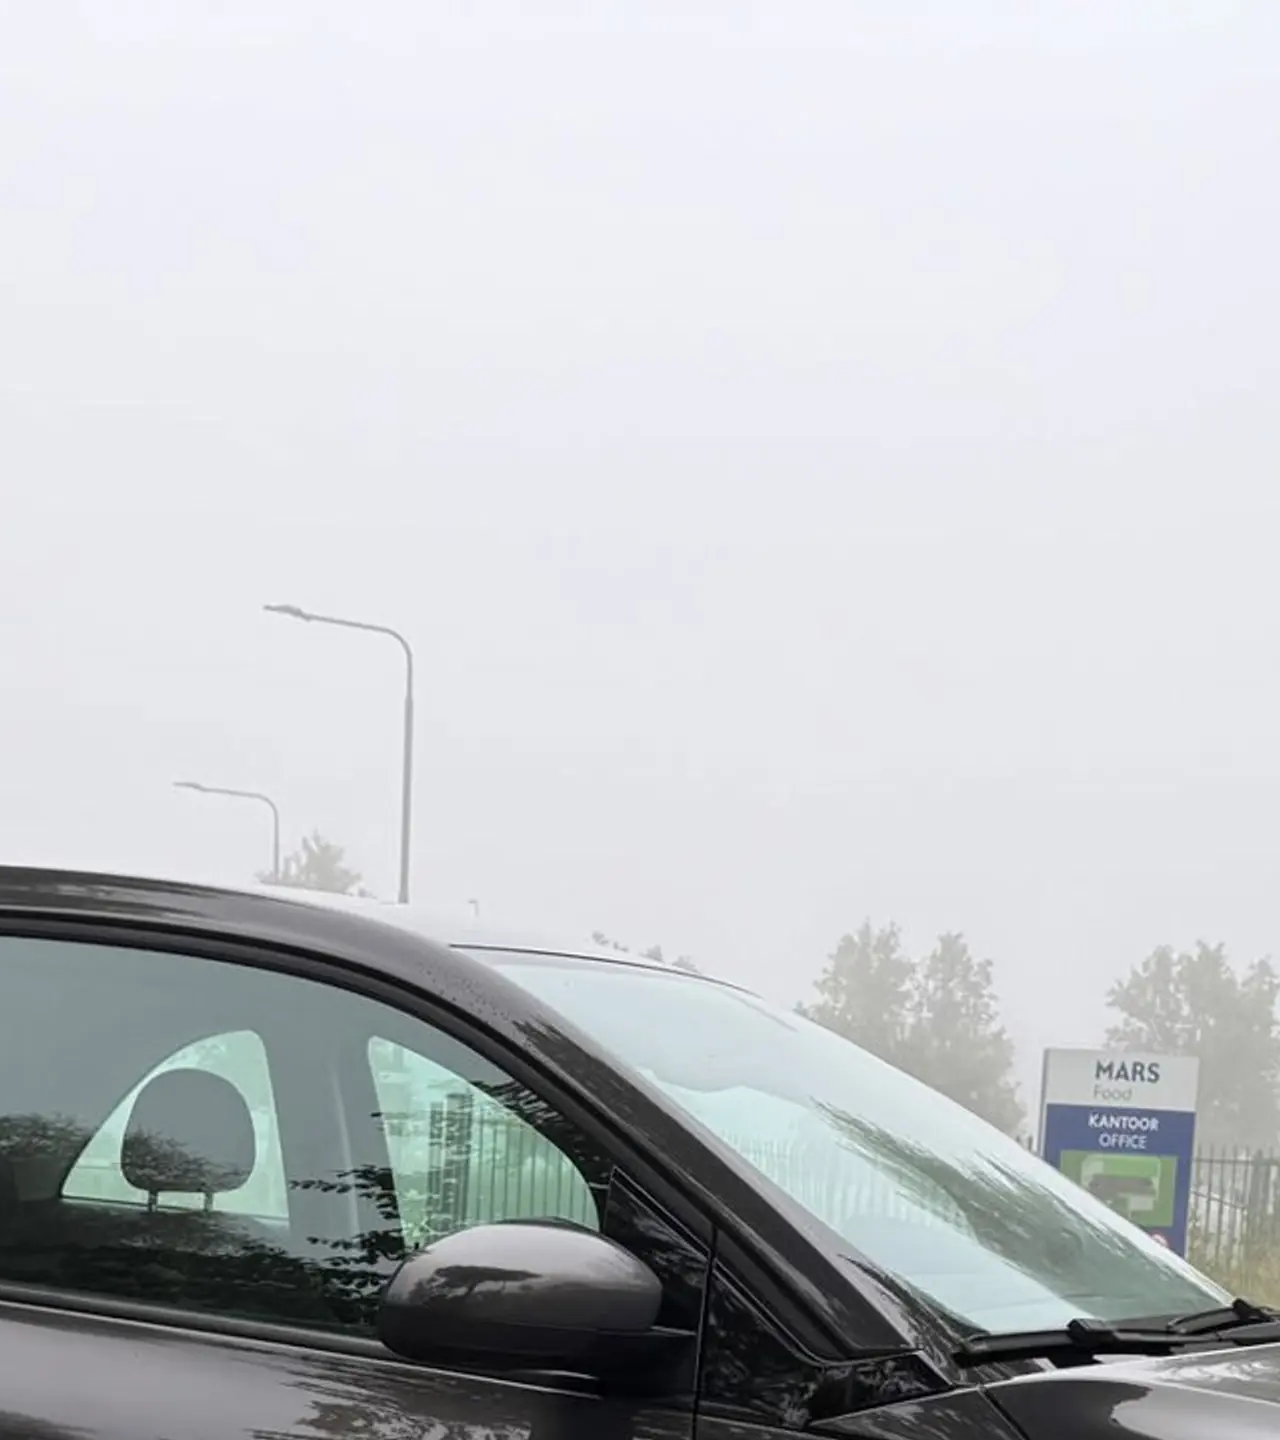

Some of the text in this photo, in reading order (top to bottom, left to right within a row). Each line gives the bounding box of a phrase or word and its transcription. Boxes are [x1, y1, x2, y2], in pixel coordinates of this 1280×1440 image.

[1095, 1060, 1160, 1084] MARS
[1093, 1084, 1132, 1100] Food
[1088, 1113, 1159, 1132] KANTOOR
[1098, 1132, 1147, 1149] OFFICE
